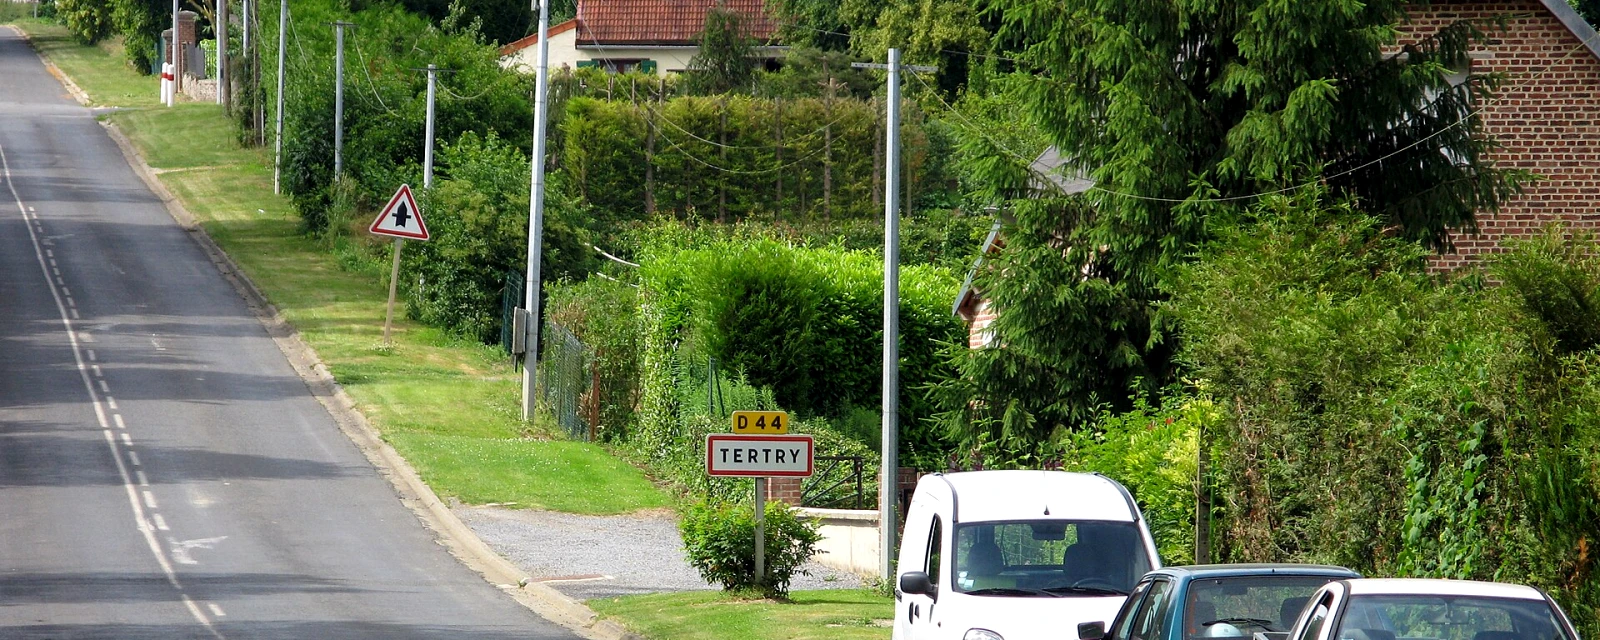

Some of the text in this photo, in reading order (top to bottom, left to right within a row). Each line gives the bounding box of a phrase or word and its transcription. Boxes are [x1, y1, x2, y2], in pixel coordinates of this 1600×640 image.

[737, 415, 782, 430] D 44
[720, 448, 800, 464] TERTRY
